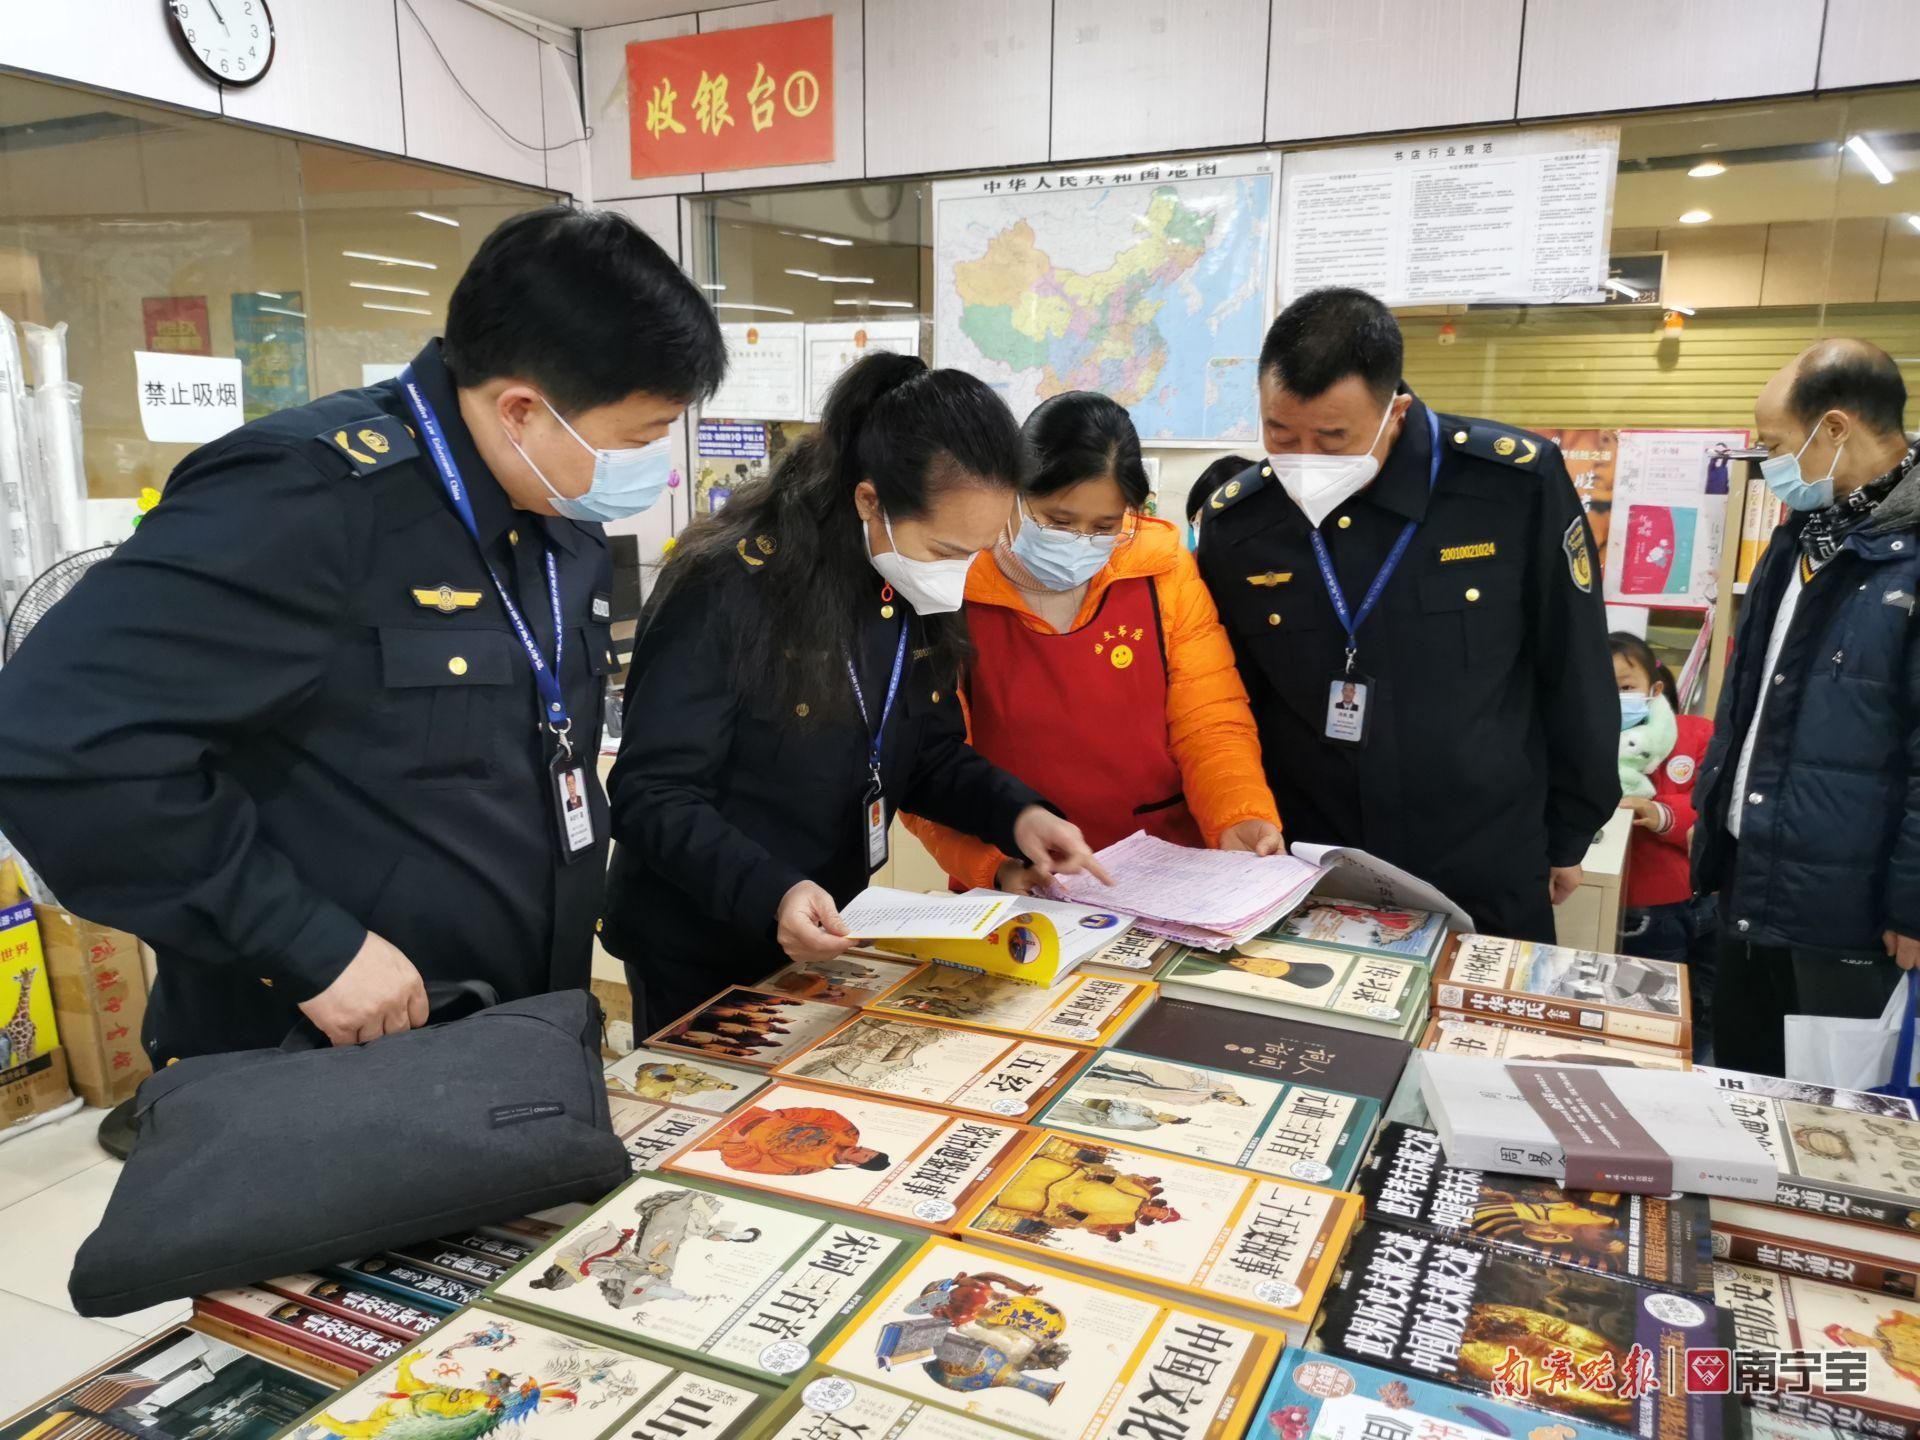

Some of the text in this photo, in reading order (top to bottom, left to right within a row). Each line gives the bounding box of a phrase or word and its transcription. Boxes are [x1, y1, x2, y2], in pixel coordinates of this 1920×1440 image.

[180, 4, 189, 19] 9
[244, 1, 252, 16] 2
[187, 28, 196, 43] 8
[250, 24, 259, 38] 3
[202, 48, 211, 62] 7
[220, 58, 229, 73] 6
[238, 57, 246, 71] 5
[248, 46, 256, 58] 4
[1393, 143, 1494, 161] 书店行业规范
[984, 163, 1217, 194] 中华人民共和国地图
[144, 380, 237, 407] 禁止吸烟
[450, 479, 461, 501] China
[1440, 542, 1496, 562] 20010021024
[1461, 944, 1506, 985] 中华姓氏
[1352, 964, 1402, 1004] 传习录
[1051, 979, 1126, 1027] 唐诗宋词元曲
[1469, 992, 1546, 1021] 中华姓氏
[983, 1054, 1052, 1094] 五经
[1266, 1089, 1341, 1161] 元曲三百首
[902, 1122, 1003, 1200] 资治通鉴故事
[1376, 1127, 1441, 1220] 世界考古未解之谜
[1230, 1187, 1311, 1280] 二十五史故事
[1756, 1244, 1857, 1283] 世界通史
[748, 1230, 882, 1340] 宋词三百首
[1344, 1231, 1429, 1360] 世界历史未解之谜
[1401, 1244, 1485, 1373] 中国历史未解之谜
